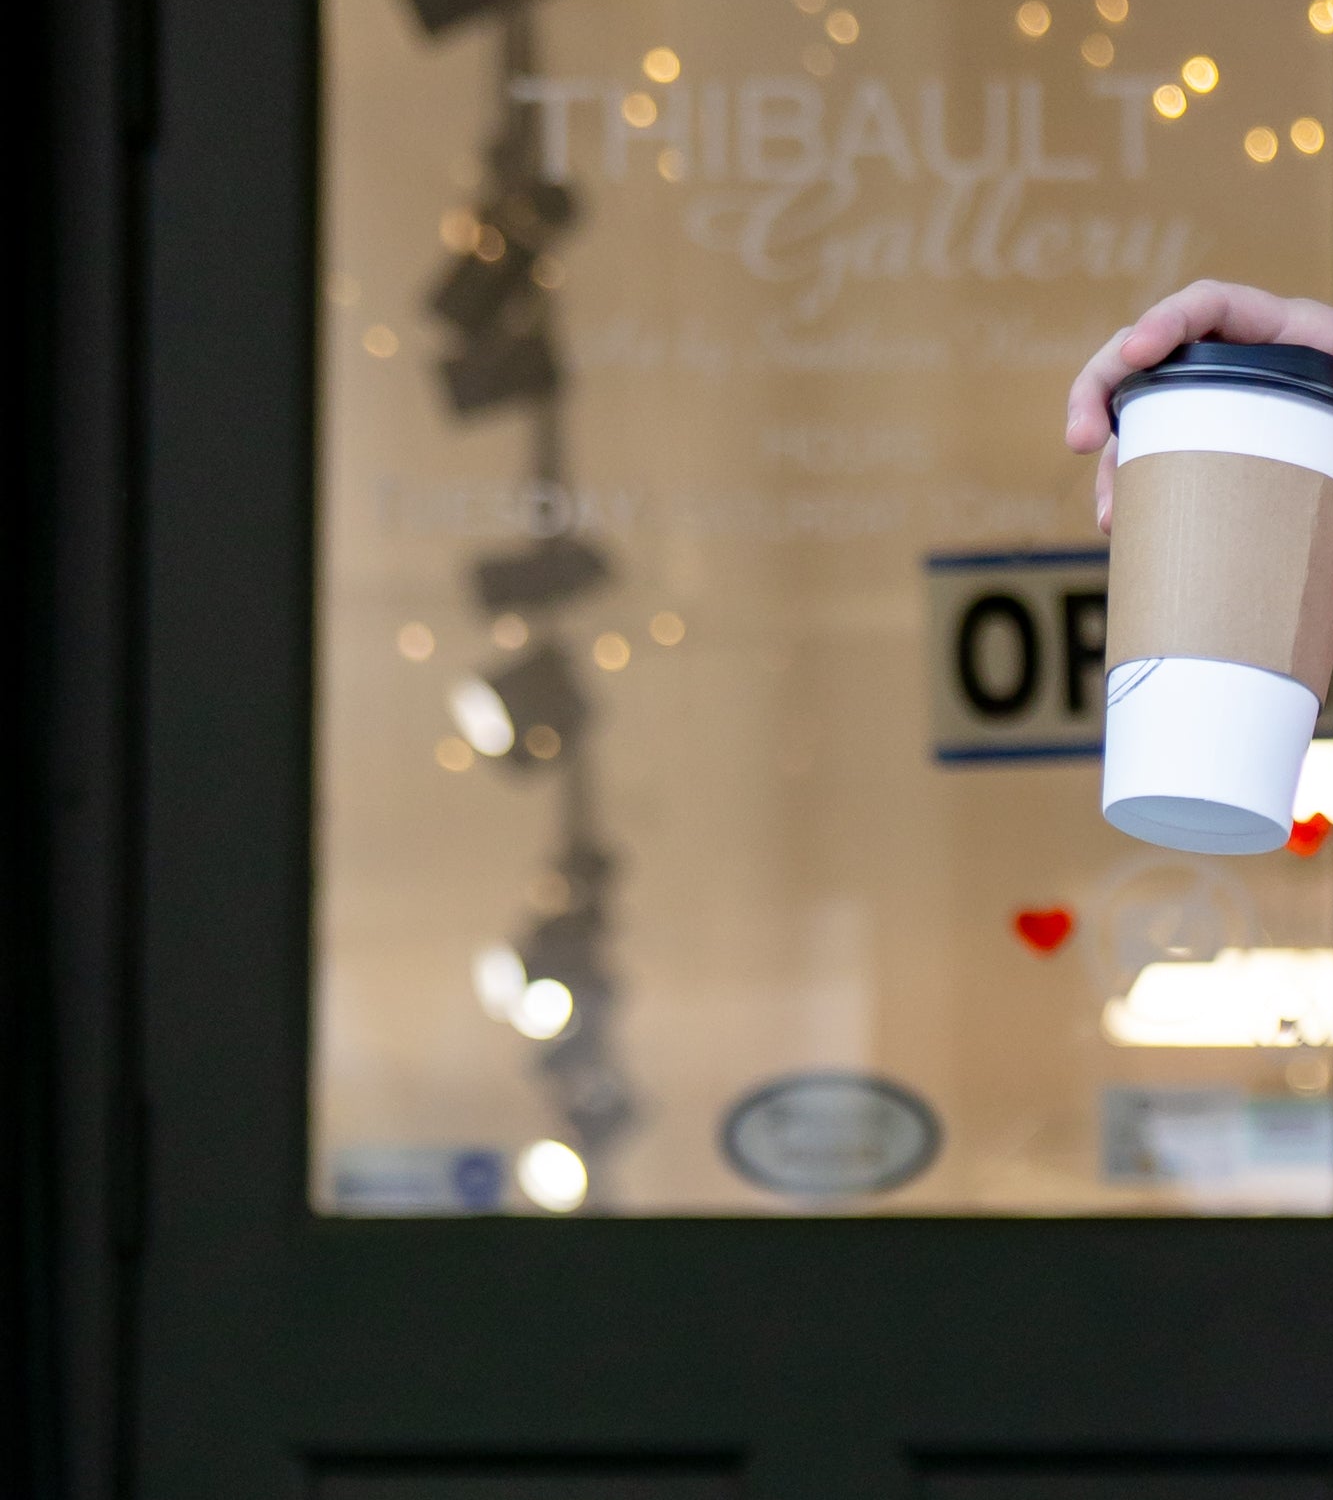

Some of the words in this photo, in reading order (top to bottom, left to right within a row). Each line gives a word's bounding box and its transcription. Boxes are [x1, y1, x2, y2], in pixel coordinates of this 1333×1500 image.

[510, 73, 1180, 183] THIBAULT
[685, 168, 1196, 314] Gallery
[956, 590, 1108, 724] OP
